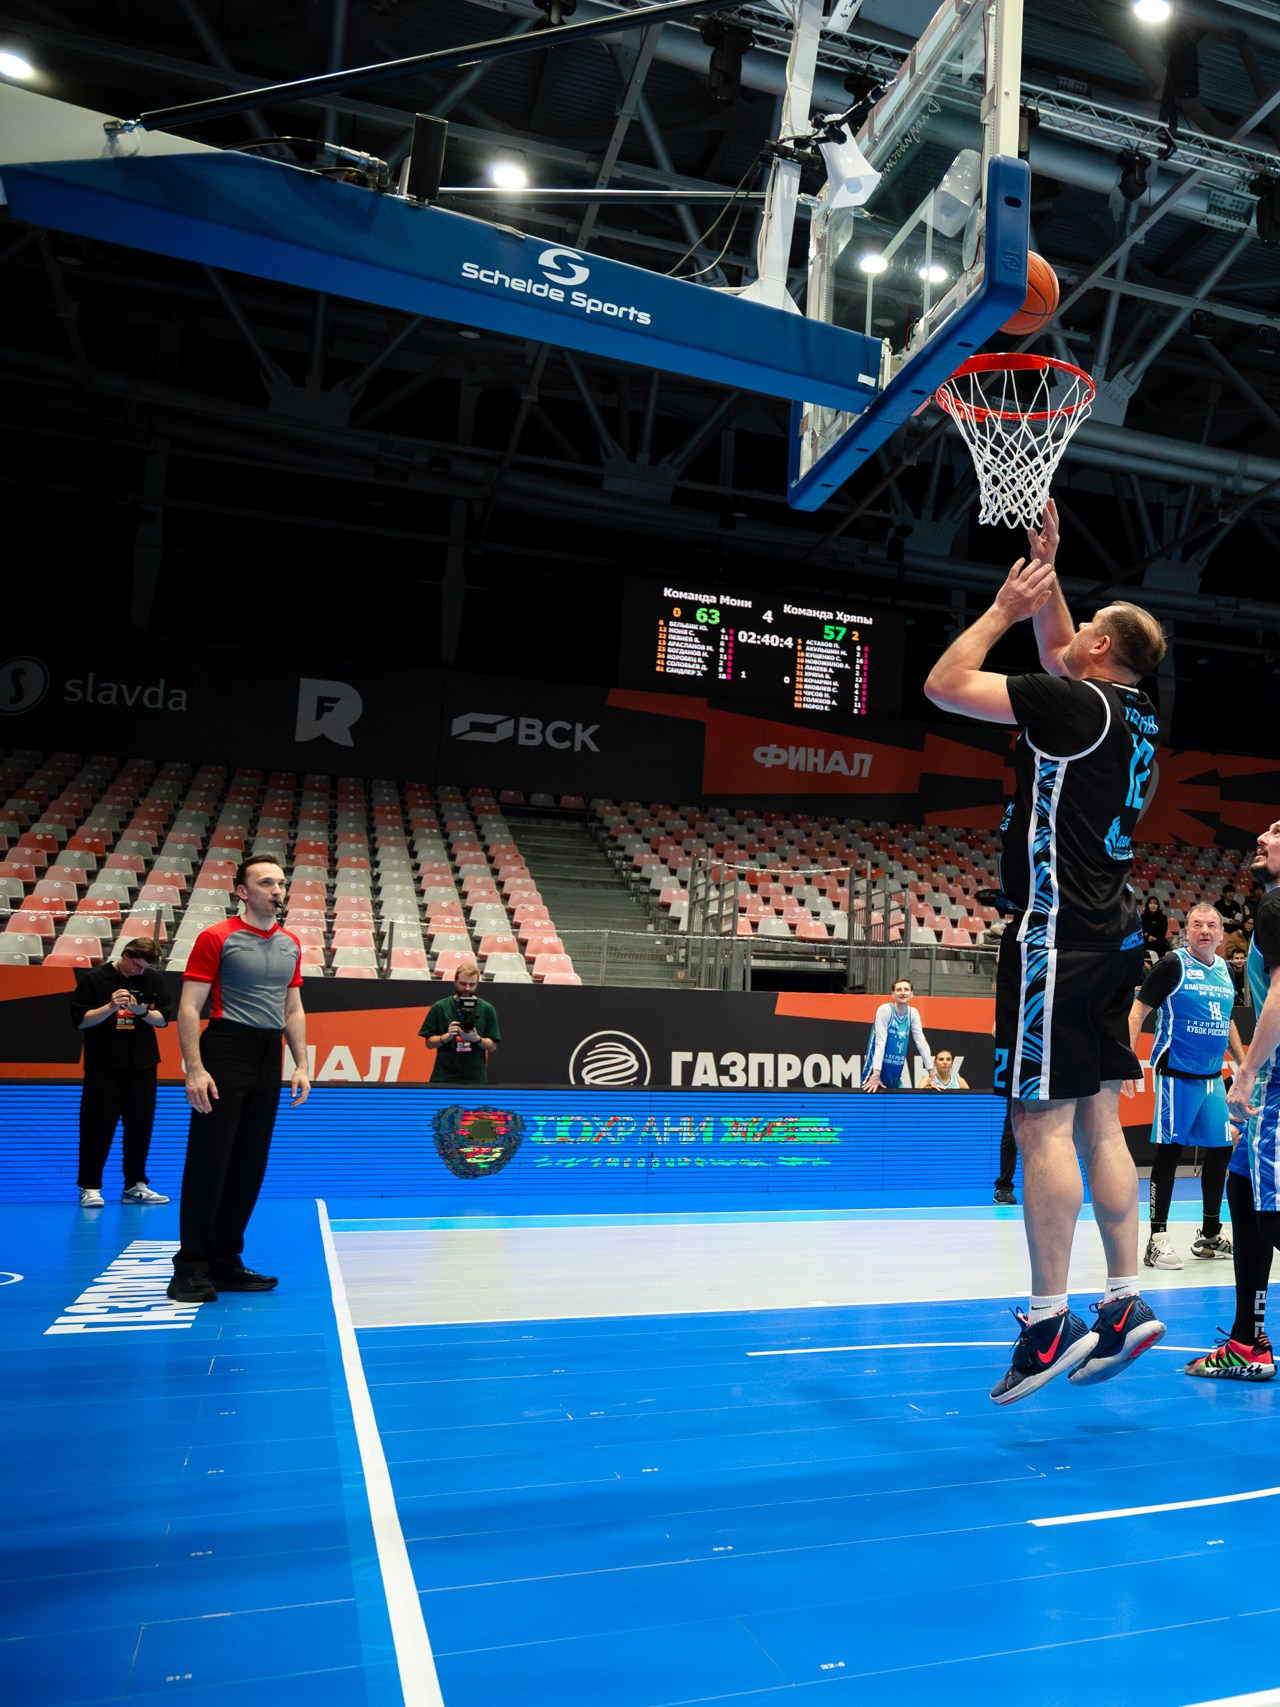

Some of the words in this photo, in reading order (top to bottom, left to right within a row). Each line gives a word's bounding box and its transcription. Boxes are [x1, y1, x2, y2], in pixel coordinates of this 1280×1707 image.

[461, 262, 565, 303] Schelde
[570, 291, 652, 326] Sports
[663, 587, 717, 604] Команда
[719, 595, 752, 609] Мони
[673, 607, 682, 618] 0
[695, 607, 721, 625] 63
[762, 610, 774, 623] 4
[783, 604, 834, 620] Команда
[836, 611, 873, 625] Хряпы
[737, 630, 794, 649] 02:40:4
[823, 624, 847, 641] 57
[851, 631, 859, 641] 2
[740, 670, 747, 679] 1
[783, 676, 791, 684] 0
[63, 671, 188, 712] slavda
[517, 717, 601, 753] ВСК
[753, 743, 873, 778] ФИНАЛ
[1199, 990, 1229, 999] МАТЧ
[1208, 1001, 1223, 1021] 18
[1187, 1025, 1207, 1035] КУБОК
